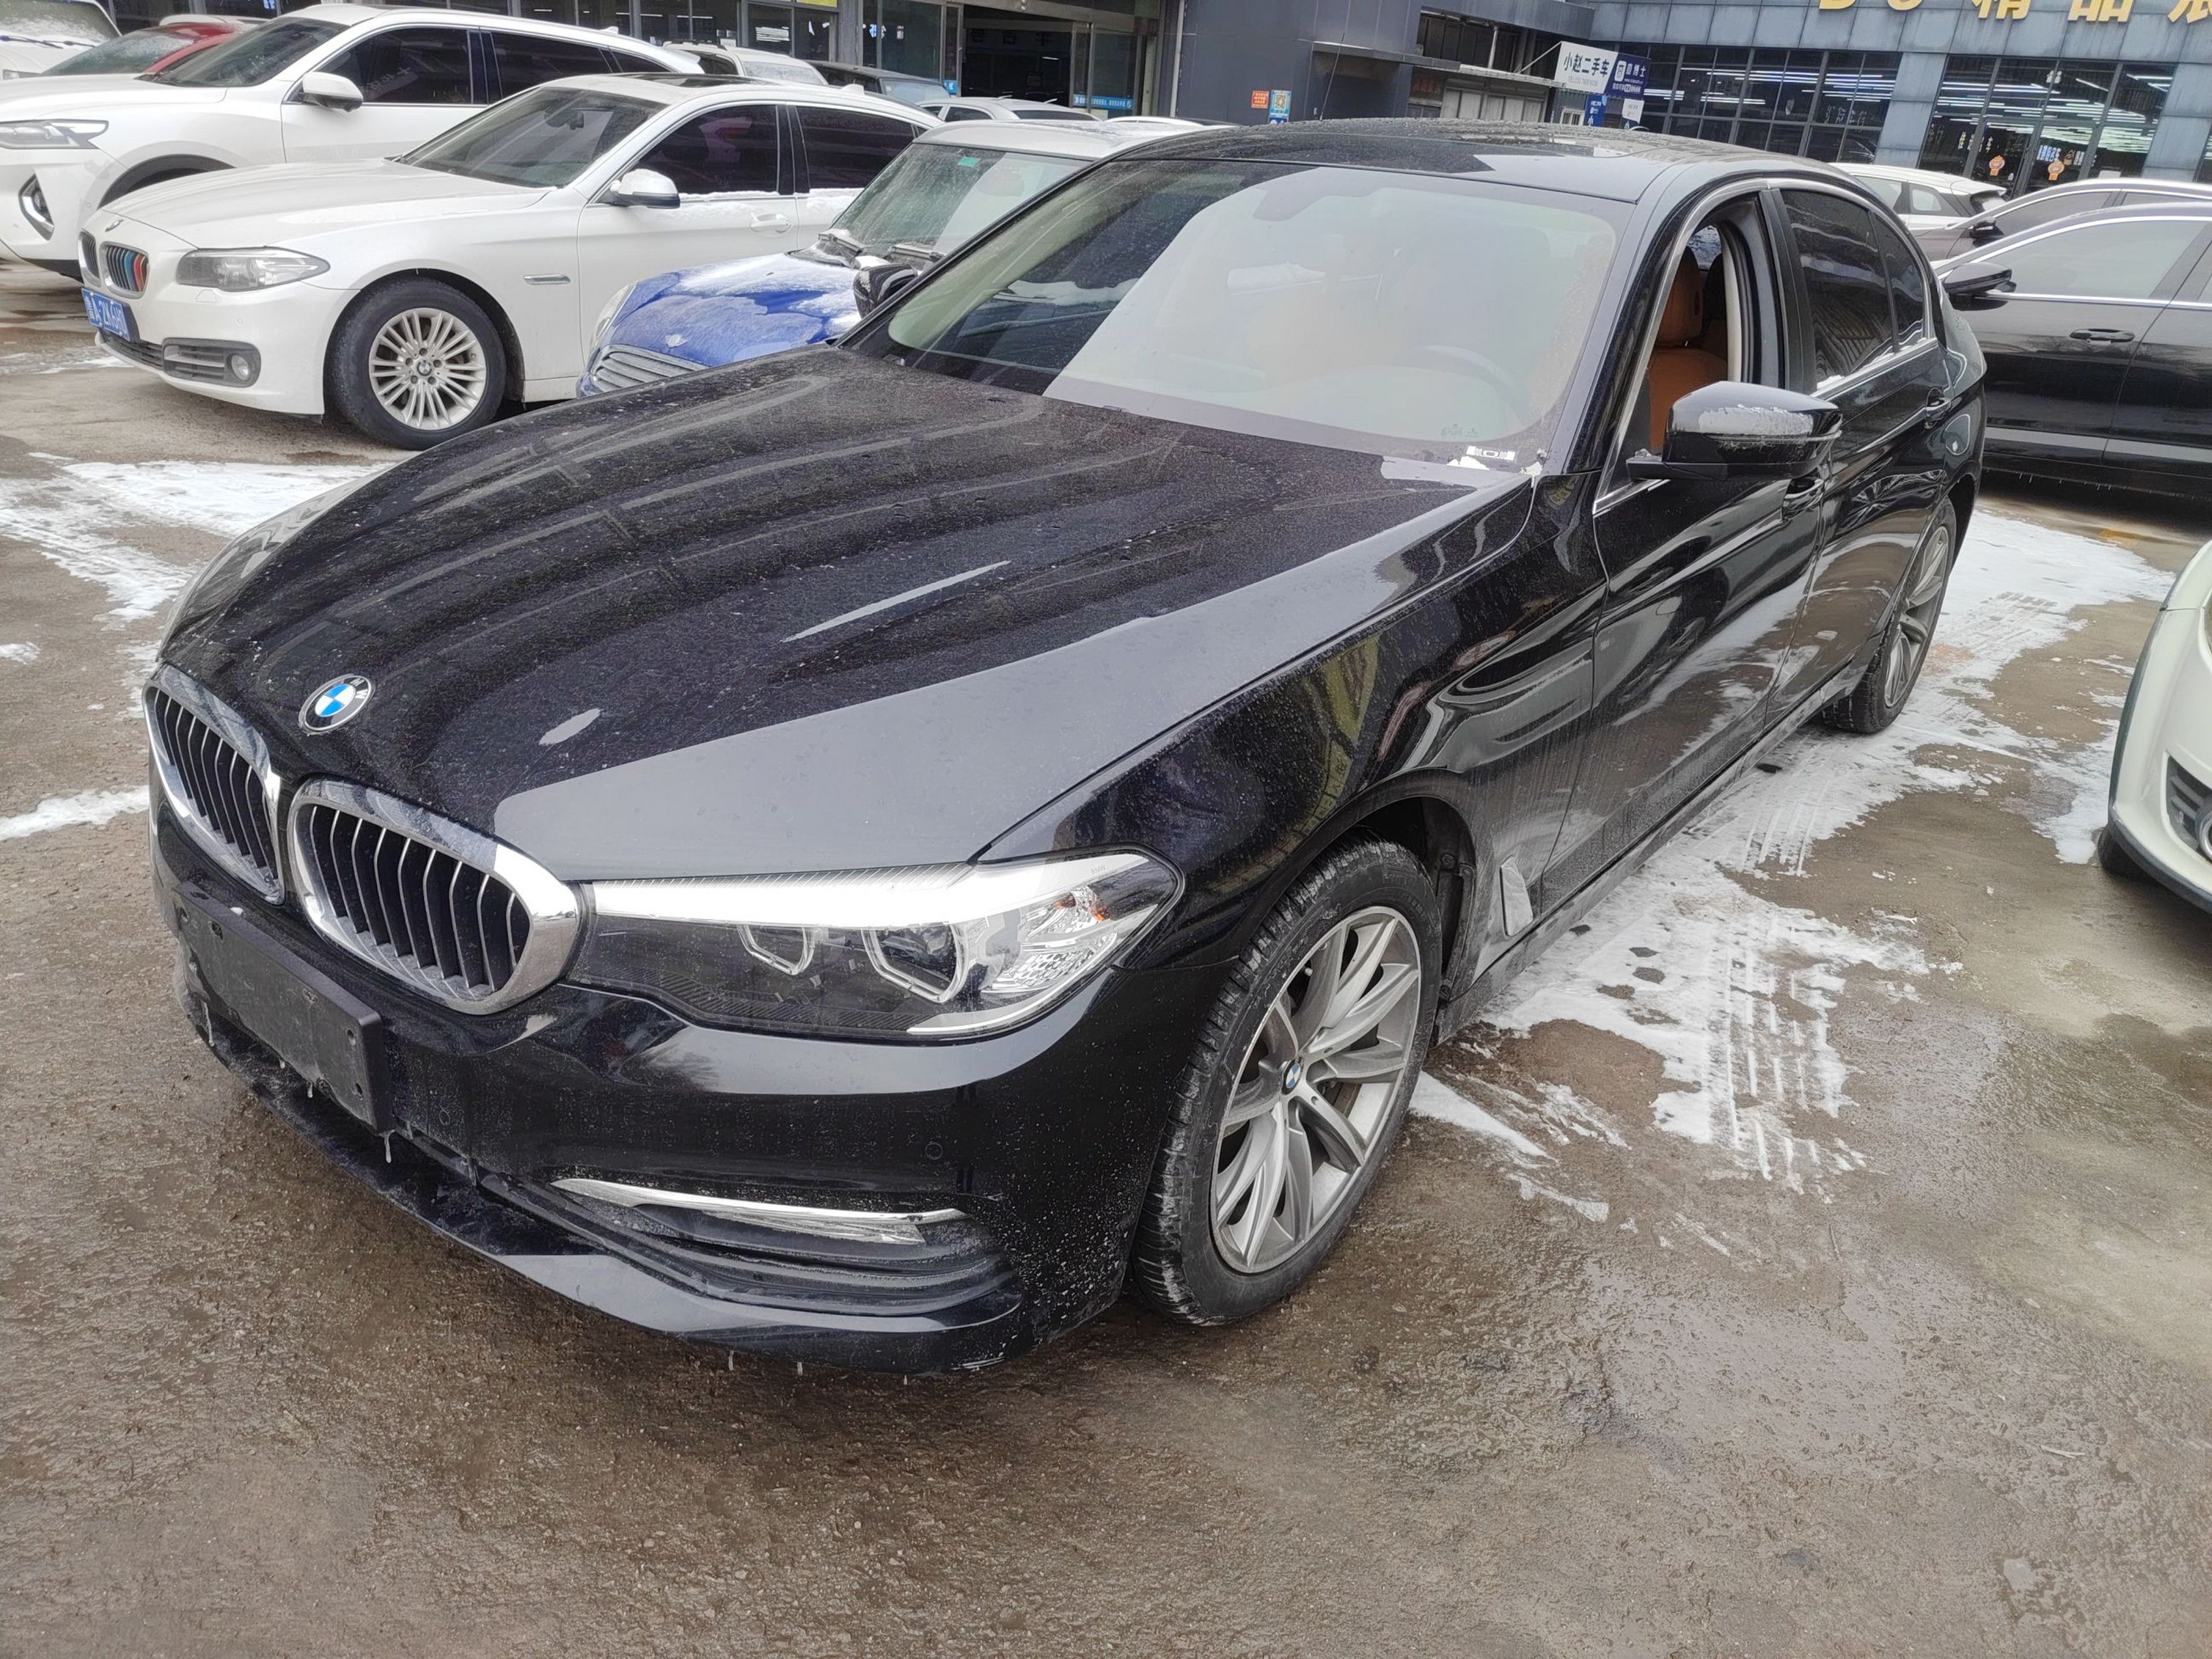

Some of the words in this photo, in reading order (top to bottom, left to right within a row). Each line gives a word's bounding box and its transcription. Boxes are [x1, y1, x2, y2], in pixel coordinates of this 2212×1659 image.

[1563, 51, 1609, 78] 小赵二手车
